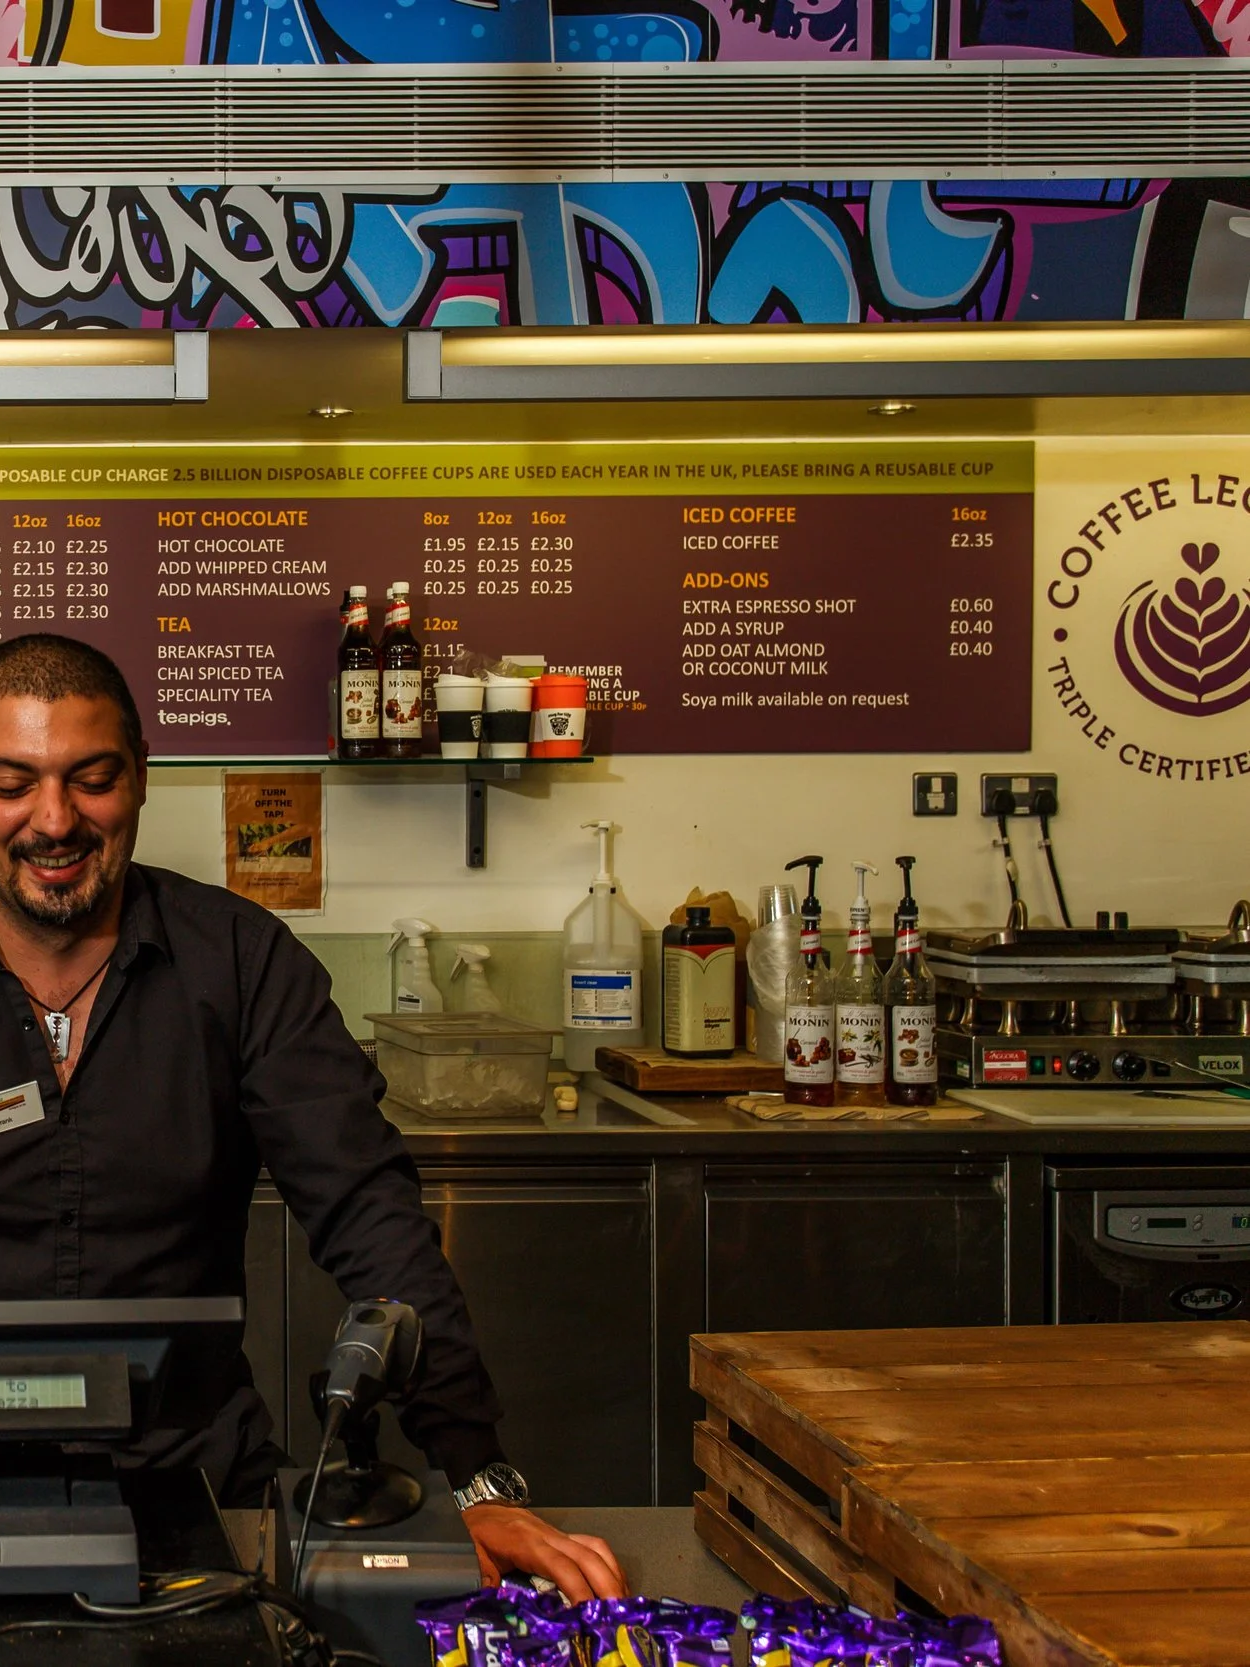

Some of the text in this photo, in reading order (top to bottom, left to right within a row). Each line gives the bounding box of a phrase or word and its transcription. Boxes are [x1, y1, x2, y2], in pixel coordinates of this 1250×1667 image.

[70, 468, 102, 482] CUP
[105, 468, 169, 482] CHARGE
[172, 462, 994, 481] 2.5 BILLION DISPOSABLE COFFEE CUPS ARE USED EACH YEAR IN THE UK, PLEASE BRING A REUSABLE CUP
[12, 513, 48, 528] 12oz
[66, 513, 101, 527] 16oz
[157, 509, 308, 527] HOT CHOCOLATE
[422, 510, 566, 525] 8oz 12oz 16oz
[683, 506, 796, 524] ICED COFFEE
[951, 506, 987, 521] 16oz
[12, 539, 55, 554] £2.10
[65, 539, 108, 554] £2.25
[157, 538, 285, 553] HOT CHOCOLATE
[423, 536, 573, 552] £1.95 £2.15 £2.30
[683, 534, 779, 550] ICED COFFEE
[950, 532, 993, 547] £2.35
[1047, 477, 1177, 609] COFFEE
[12, 561, 55, 576] £2.15
[65, 561, 109, 576] £2.30
[157, 559, 327, 575] ADD WHIPPED CREAM
[423, 557, 573, 573] £0.25 £0.25 £0.25
[423, 579, 573, 595] £0.25 £0.25 £0.25
[682, 571, 769, 589] ADD-ONS
[12, 583, 55, 598] £2.15
[65, 582, 109, 597] £2.30
[157, 581, 331, 597] ADD MARSHMALLOWS
[13, 604, 55, 619] £2.15
[66, 604, 109, 619] £2.30
[683, 598, 857, 614] EXTRA ESPRESSO SHOT
[949, 597, 993, 613] £0.60
[156, 616, 191, 632] TEA
[423, 616, 458, 631] 12oz
[681, 621, 784, 636] ADD A SYRUP
[949, 619, 993, 634] £0.40
[157, 644, 275, 659] BREAKFAST TEA
[681, 642, 825, 658] ADD OAT ALMOND
[949, 641, 993, 656] £0.40
[157, 665, 284, 681] CHAI SPICED TEA
[681, 660, 828, 676] OR COCONUT MILK
[612, 678, 623, 689] A
[156, 687, 273, 702] SPECIALITY TEA
[613, 690, 641, 701] CUP
[681, 690, 909, 710] Soya milk available on request
[604, 702, 624, 711] CUP
[156, 709, 231, 727] teapigs.
[1047, 656, 1250, 782] TRIPLE CERTIFIE
[260, 788, 287, 797] TURN
[254, 798, 293, 808] OFF THE
[788, 1016, 830, 1028] MONIN
[839, 1016, 882, 1027] MONIN
[1201, 1060, 1240, 1071] VELOX
[5, 1379, 27, 1393] to
